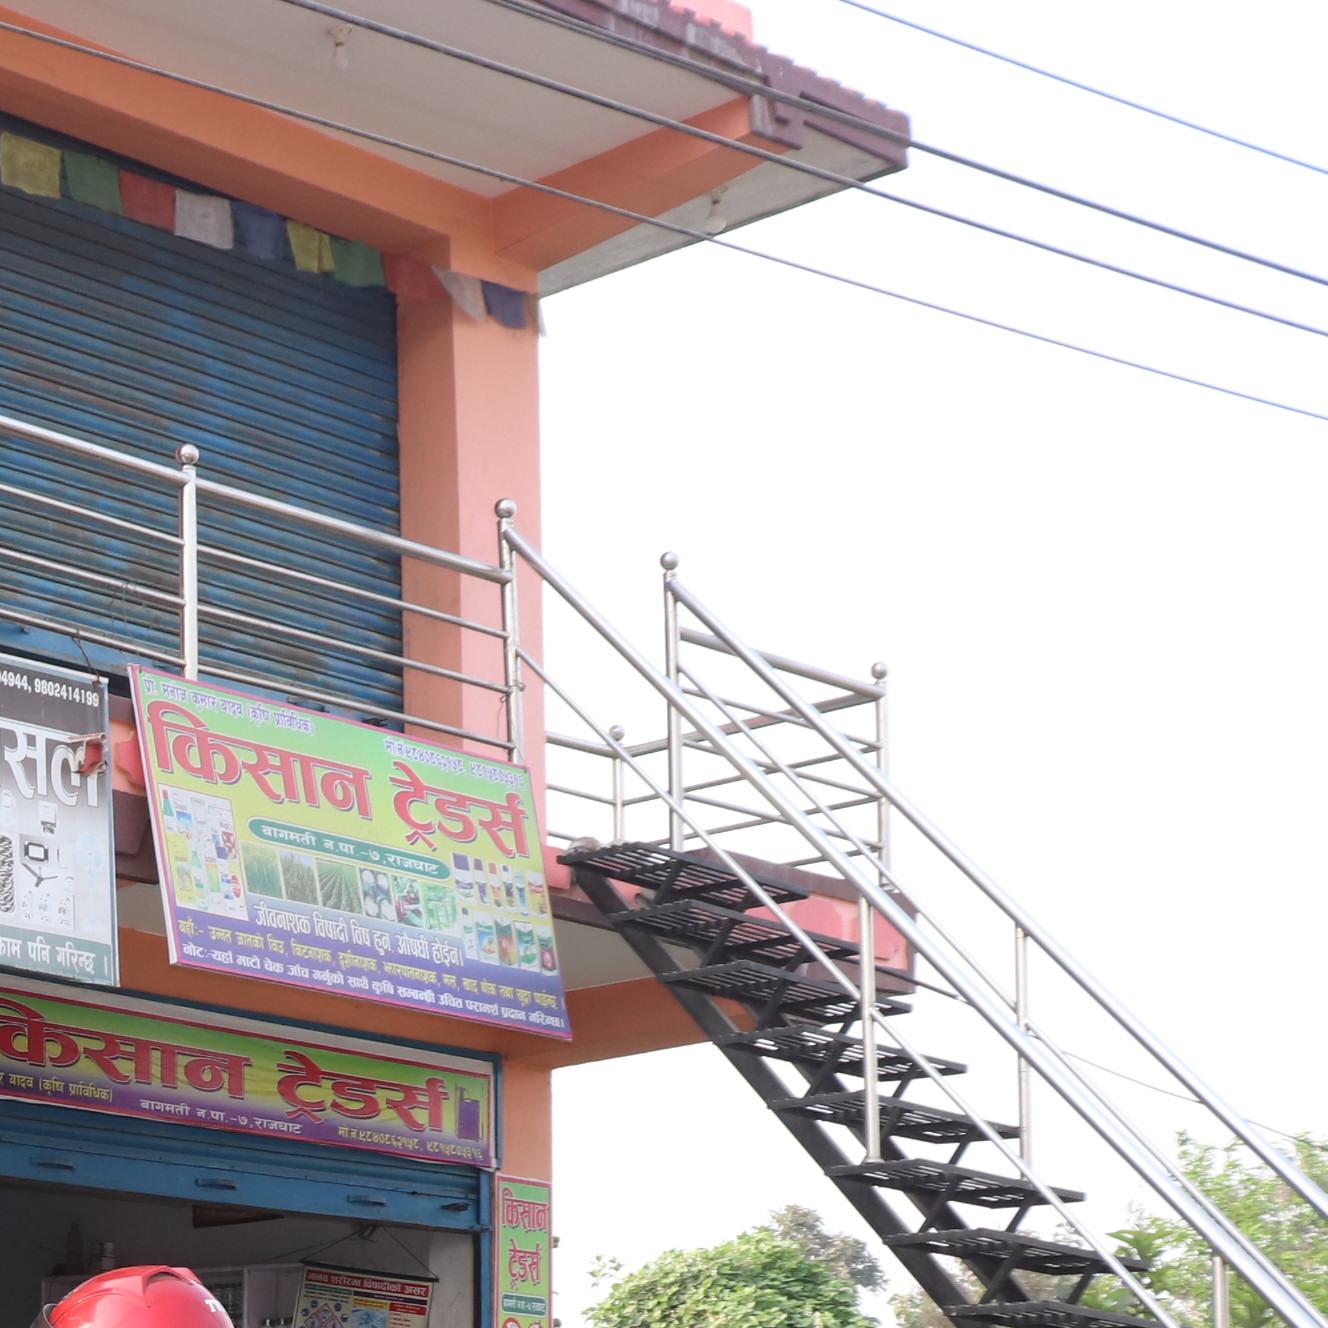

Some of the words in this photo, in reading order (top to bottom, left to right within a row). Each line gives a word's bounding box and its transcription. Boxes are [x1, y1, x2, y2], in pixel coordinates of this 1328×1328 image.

[34, 677, 100, 708] 9802414199
[189, 690, 217, 714] कुमार
[219, 698, 244, 718] यादव
[147, 699, 373, 821] किसान
[389, 760, 530, 859] ट्रेडर्स
[253, 900, 312, 936] जीवनाशक
[312, 909, 350, 945] विषादी
[26, 935, 51, 964] पनि
[55, 940, 96, 974] गरिन्छ
[236, 954, 262, 970] माटो
[263, 956, 285, 975] चेक
[9, 1072, 35, 1090] यादव
[276, 1049, 450, 1133] ट्रेडर्स
[502, 1187, 548, 1234] किसान
[508, 1237, 543, 1291] ट्रेडर्स
[404, 1284, 427, 1297] असर
